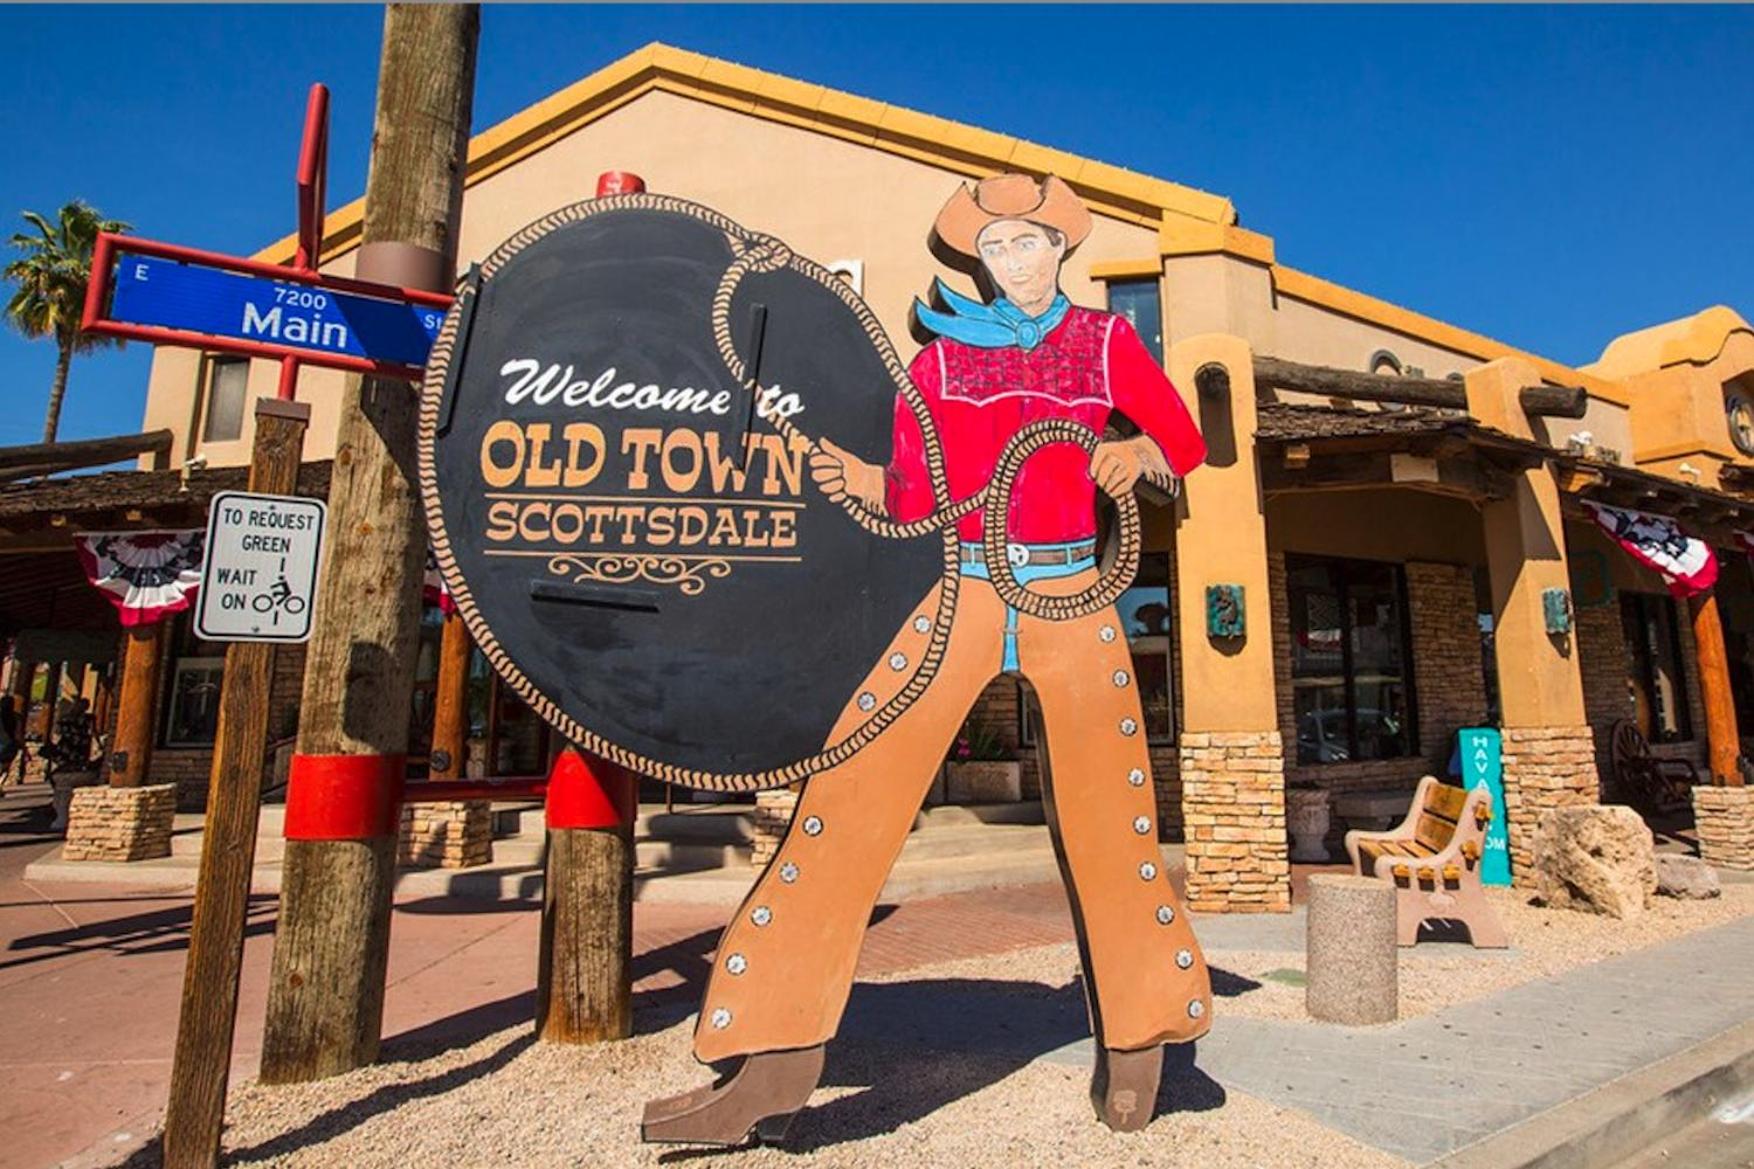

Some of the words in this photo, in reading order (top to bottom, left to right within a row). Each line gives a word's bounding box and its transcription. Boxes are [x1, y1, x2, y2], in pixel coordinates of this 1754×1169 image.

[135, 264, 148, 281] E
[273, 287, 327, 310] 7200
[241, 302, 347, 348] Main
[500, 358, 731, 415] Welcome
[755, 384, 806, 418] to
[480, 420, 607, 488] OLD
[621, 427, 808, 496] TOWN
[224, 508, 243, 525] TO
[248, 510, 315, 530] REQUEST
[485, 502, 797, 548] SCOTTSDALE
[242, 534, 291, 553] GREEN
[217, 567, 257, 586] WAIT
[221, 593, 247, 610] ON
